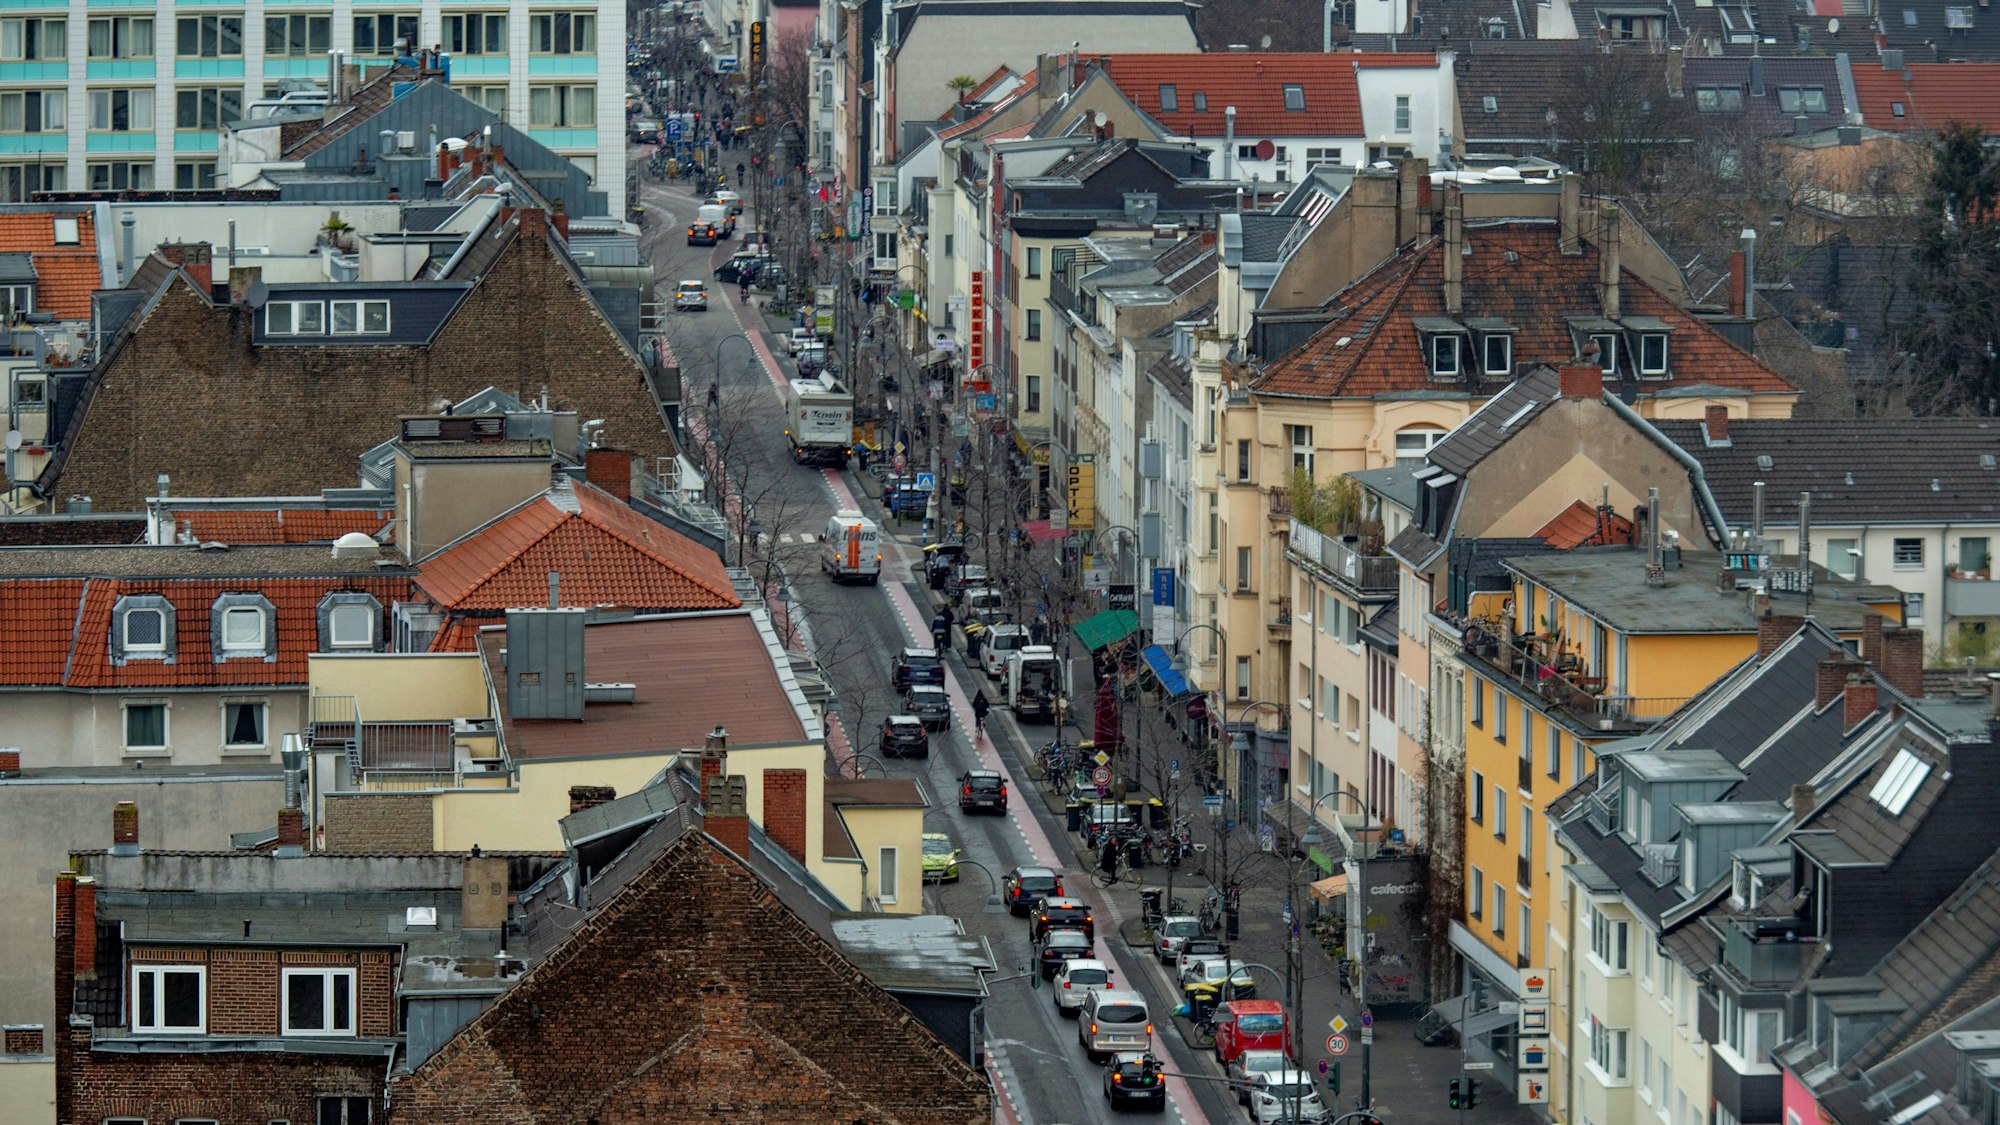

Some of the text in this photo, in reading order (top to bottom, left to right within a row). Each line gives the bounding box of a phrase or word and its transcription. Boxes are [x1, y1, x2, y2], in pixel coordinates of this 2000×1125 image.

[973, 271, 982, 369] BÄCKEREI
[1069, 466, 1080, 519] OPTIK
[1331, 1040, 1344, 1050] 30
